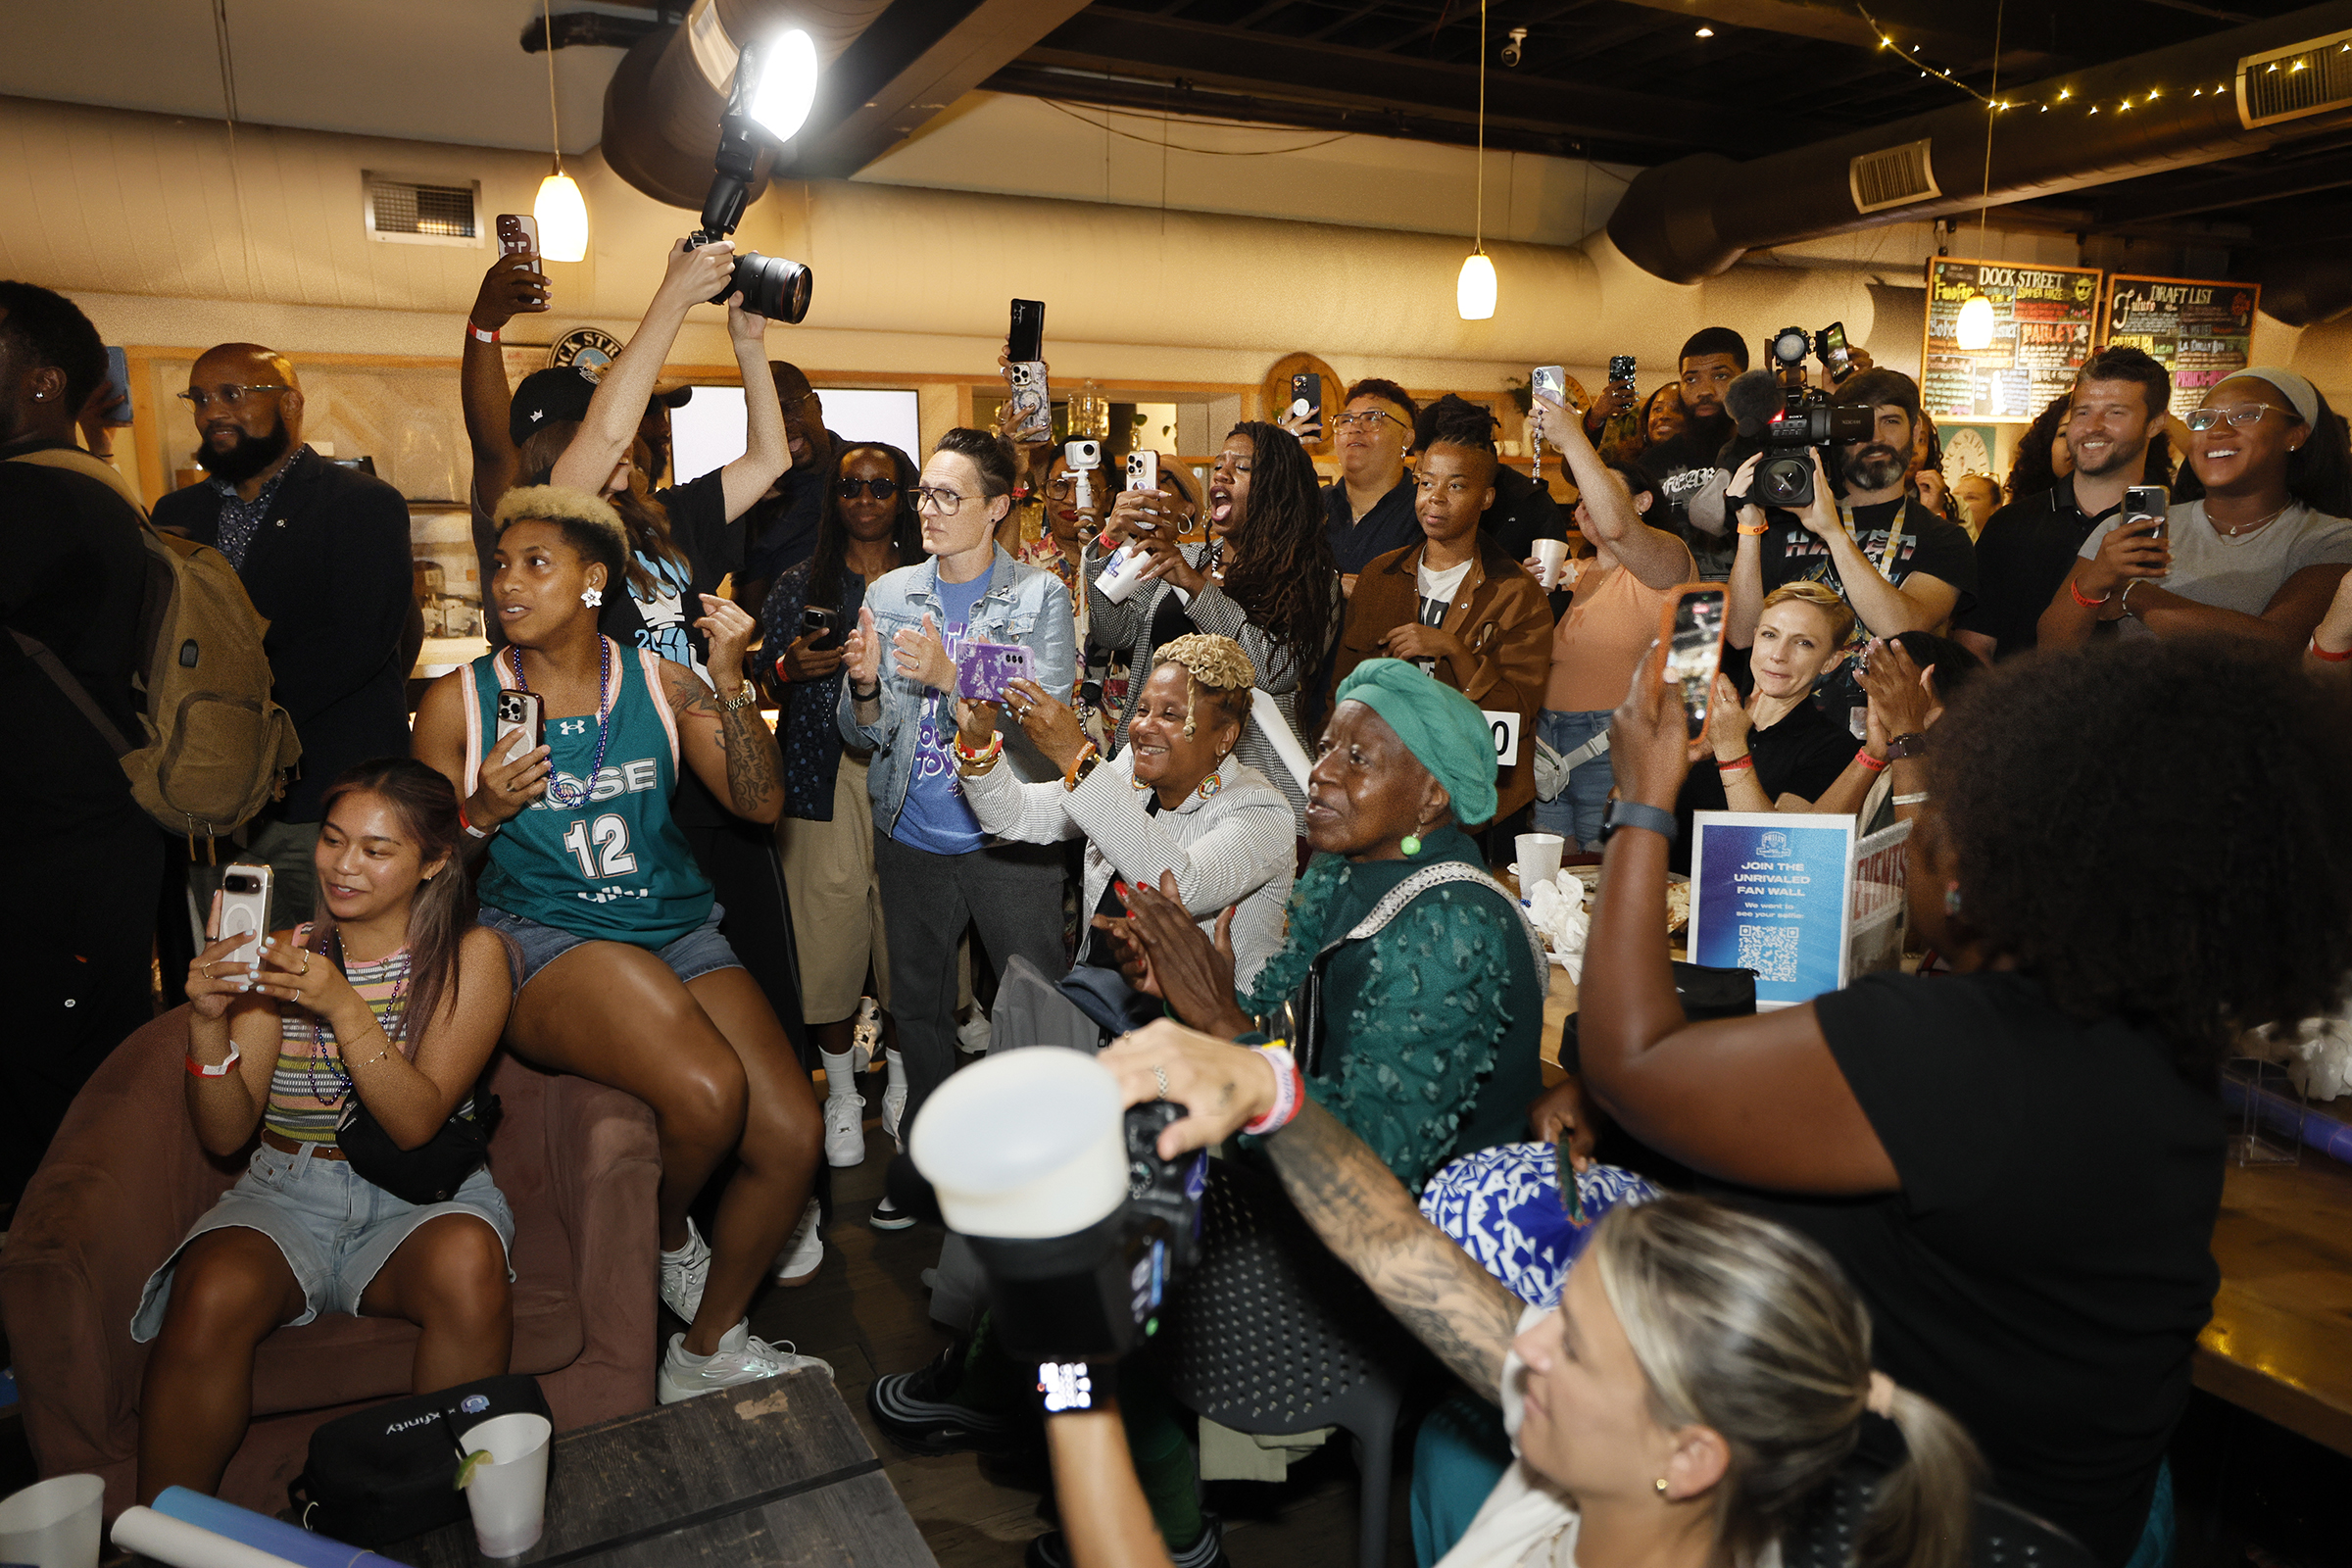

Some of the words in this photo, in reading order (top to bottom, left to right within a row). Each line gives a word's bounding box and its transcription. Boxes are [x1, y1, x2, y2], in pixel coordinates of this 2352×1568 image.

[1979, 266, 2016, 287] DOCK
[2017, 270, 2065, 289] STREET
[2150, 284, 2188, 305] DRAFT
[2187, 287, 2214, 305] LIST
[564, 812, 638, 879] 12
[1740, 861, 1774, 870] JOIN
[1777, 862, 1804, 871] THE
[1734, 873, 1811, 885] UNRIVALED
[1737, 886, 1765, 896] FAN
[1767, 887, 1806, 897] WALL
[386, 1411, 441, 1436] xfinity
